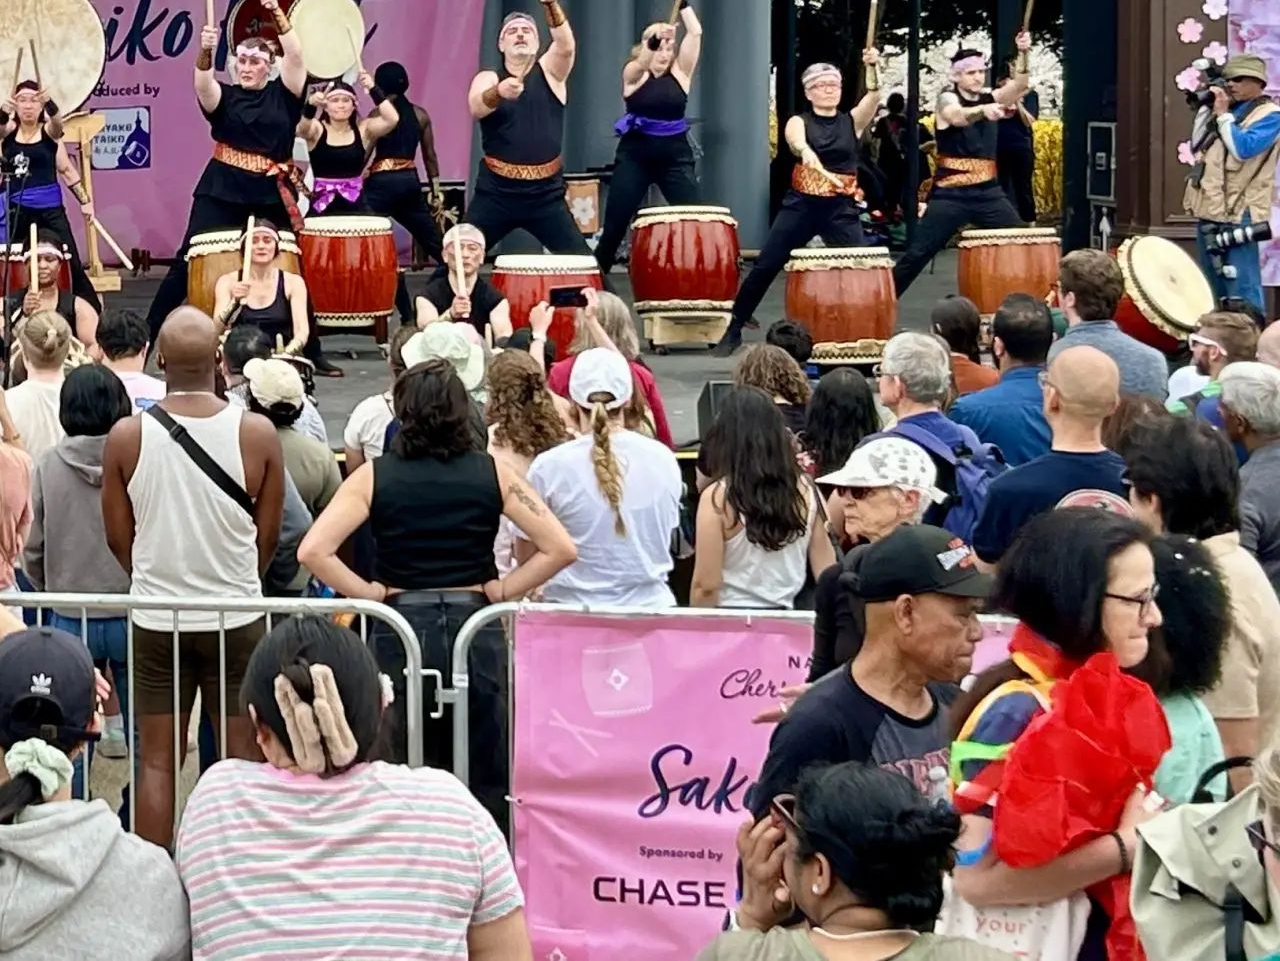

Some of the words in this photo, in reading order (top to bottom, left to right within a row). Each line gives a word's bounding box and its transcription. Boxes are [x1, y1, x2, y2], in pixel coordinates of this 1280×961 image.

[92, 83, 141, 97] oduced
[143, 83, 160, 98] by
[720, 668, 787, 699] Cher
[638, 744, 753, 818] Sak
[639, 845, 705, 860] Sponsored
[707, 850, 724, 863] by
[593, 876, 727, 909] CHASE
[976, 916, 1025, 934] your
